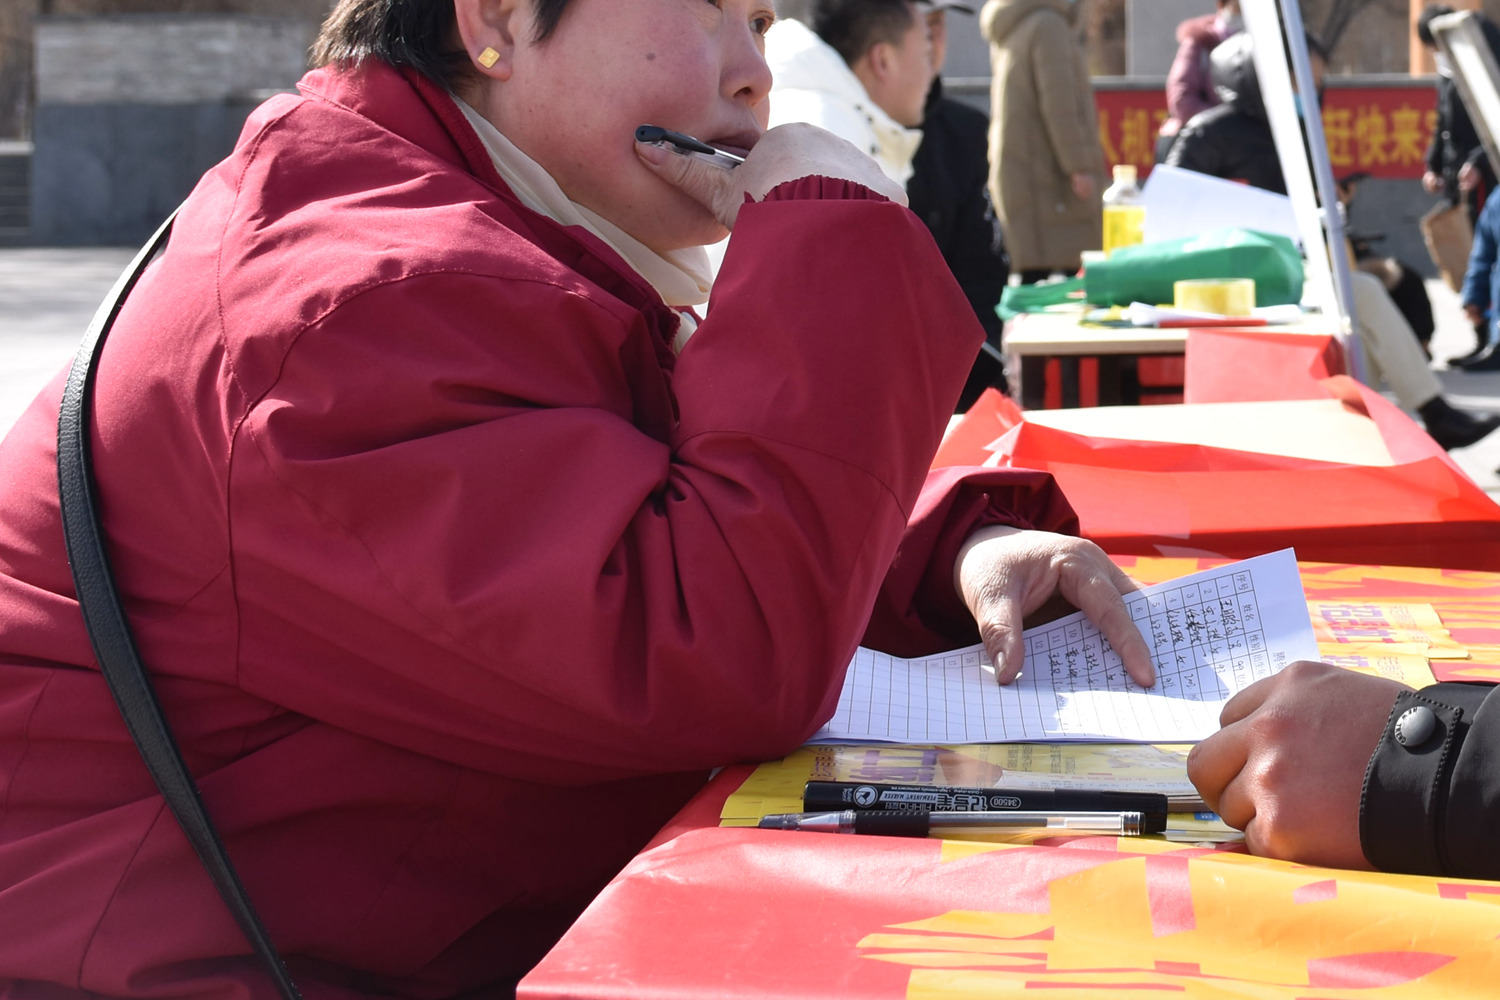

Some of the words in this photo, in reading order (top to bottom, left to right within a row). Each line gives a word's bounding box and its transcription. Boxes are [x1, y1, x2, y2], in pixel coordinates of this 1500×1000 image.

[1237, 574, 1249, 591] 序号
[1243, 603, 1255, 622] 姓名
[1249, 634, 1262, 652] 性别
[1068, 629, 1078, 639] 10
[1034, 639, 1044, 649] 12
[1051, 635, 1061, 644] 11
[884, 792, 905, 800] MARKER
[906, 792, 937, 801] PERMANENT
[935, 794, 988, 812] 记号笔
[994, 798, 1018, 806] 34500
